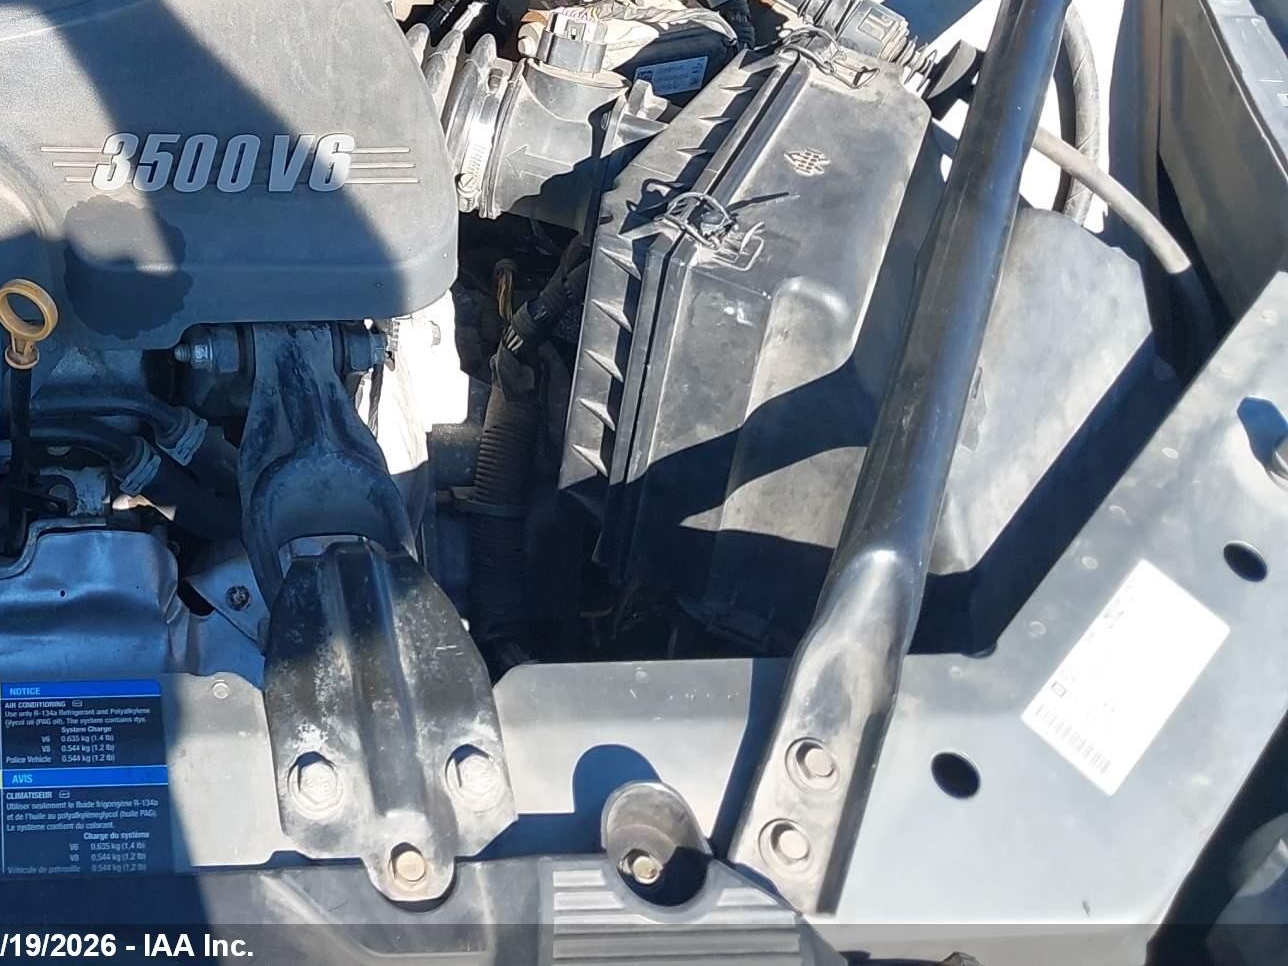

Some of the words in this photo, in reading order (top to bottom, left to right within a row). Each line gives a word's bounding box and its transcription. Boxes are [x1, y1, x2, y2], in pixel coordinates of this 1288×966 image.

[92, 133, 261, 193] 3500
[268, 133, 355, 192] V6
[10, 687, 40, 696] NOTICE
[59, 709, 95, 717] Refrigerant
[5, 719, 25, 727] Glycol
[80, 717, 103, 725] system
[61, 726, 86, 734] System
[82, 735, 90, 743] kg
[82, 744, 90, 753] kg
[92, 744, 104, 752] (1.2
[106, 744, 114, 752] lb)
[82, 754, 91, 763] kg
[92, 754, 104, 762] (1.2
[106, 754, 115, 762] lb)
[12, 775, 33, 783] AVIS
[6, 792, 52, 800] CLIMATISEUR
[83, 832, 108, 840] Charge
[70, 843, 78, 851] V6
[112, 842, 120, 851] kg
[112, 853, 121, 862] kg
